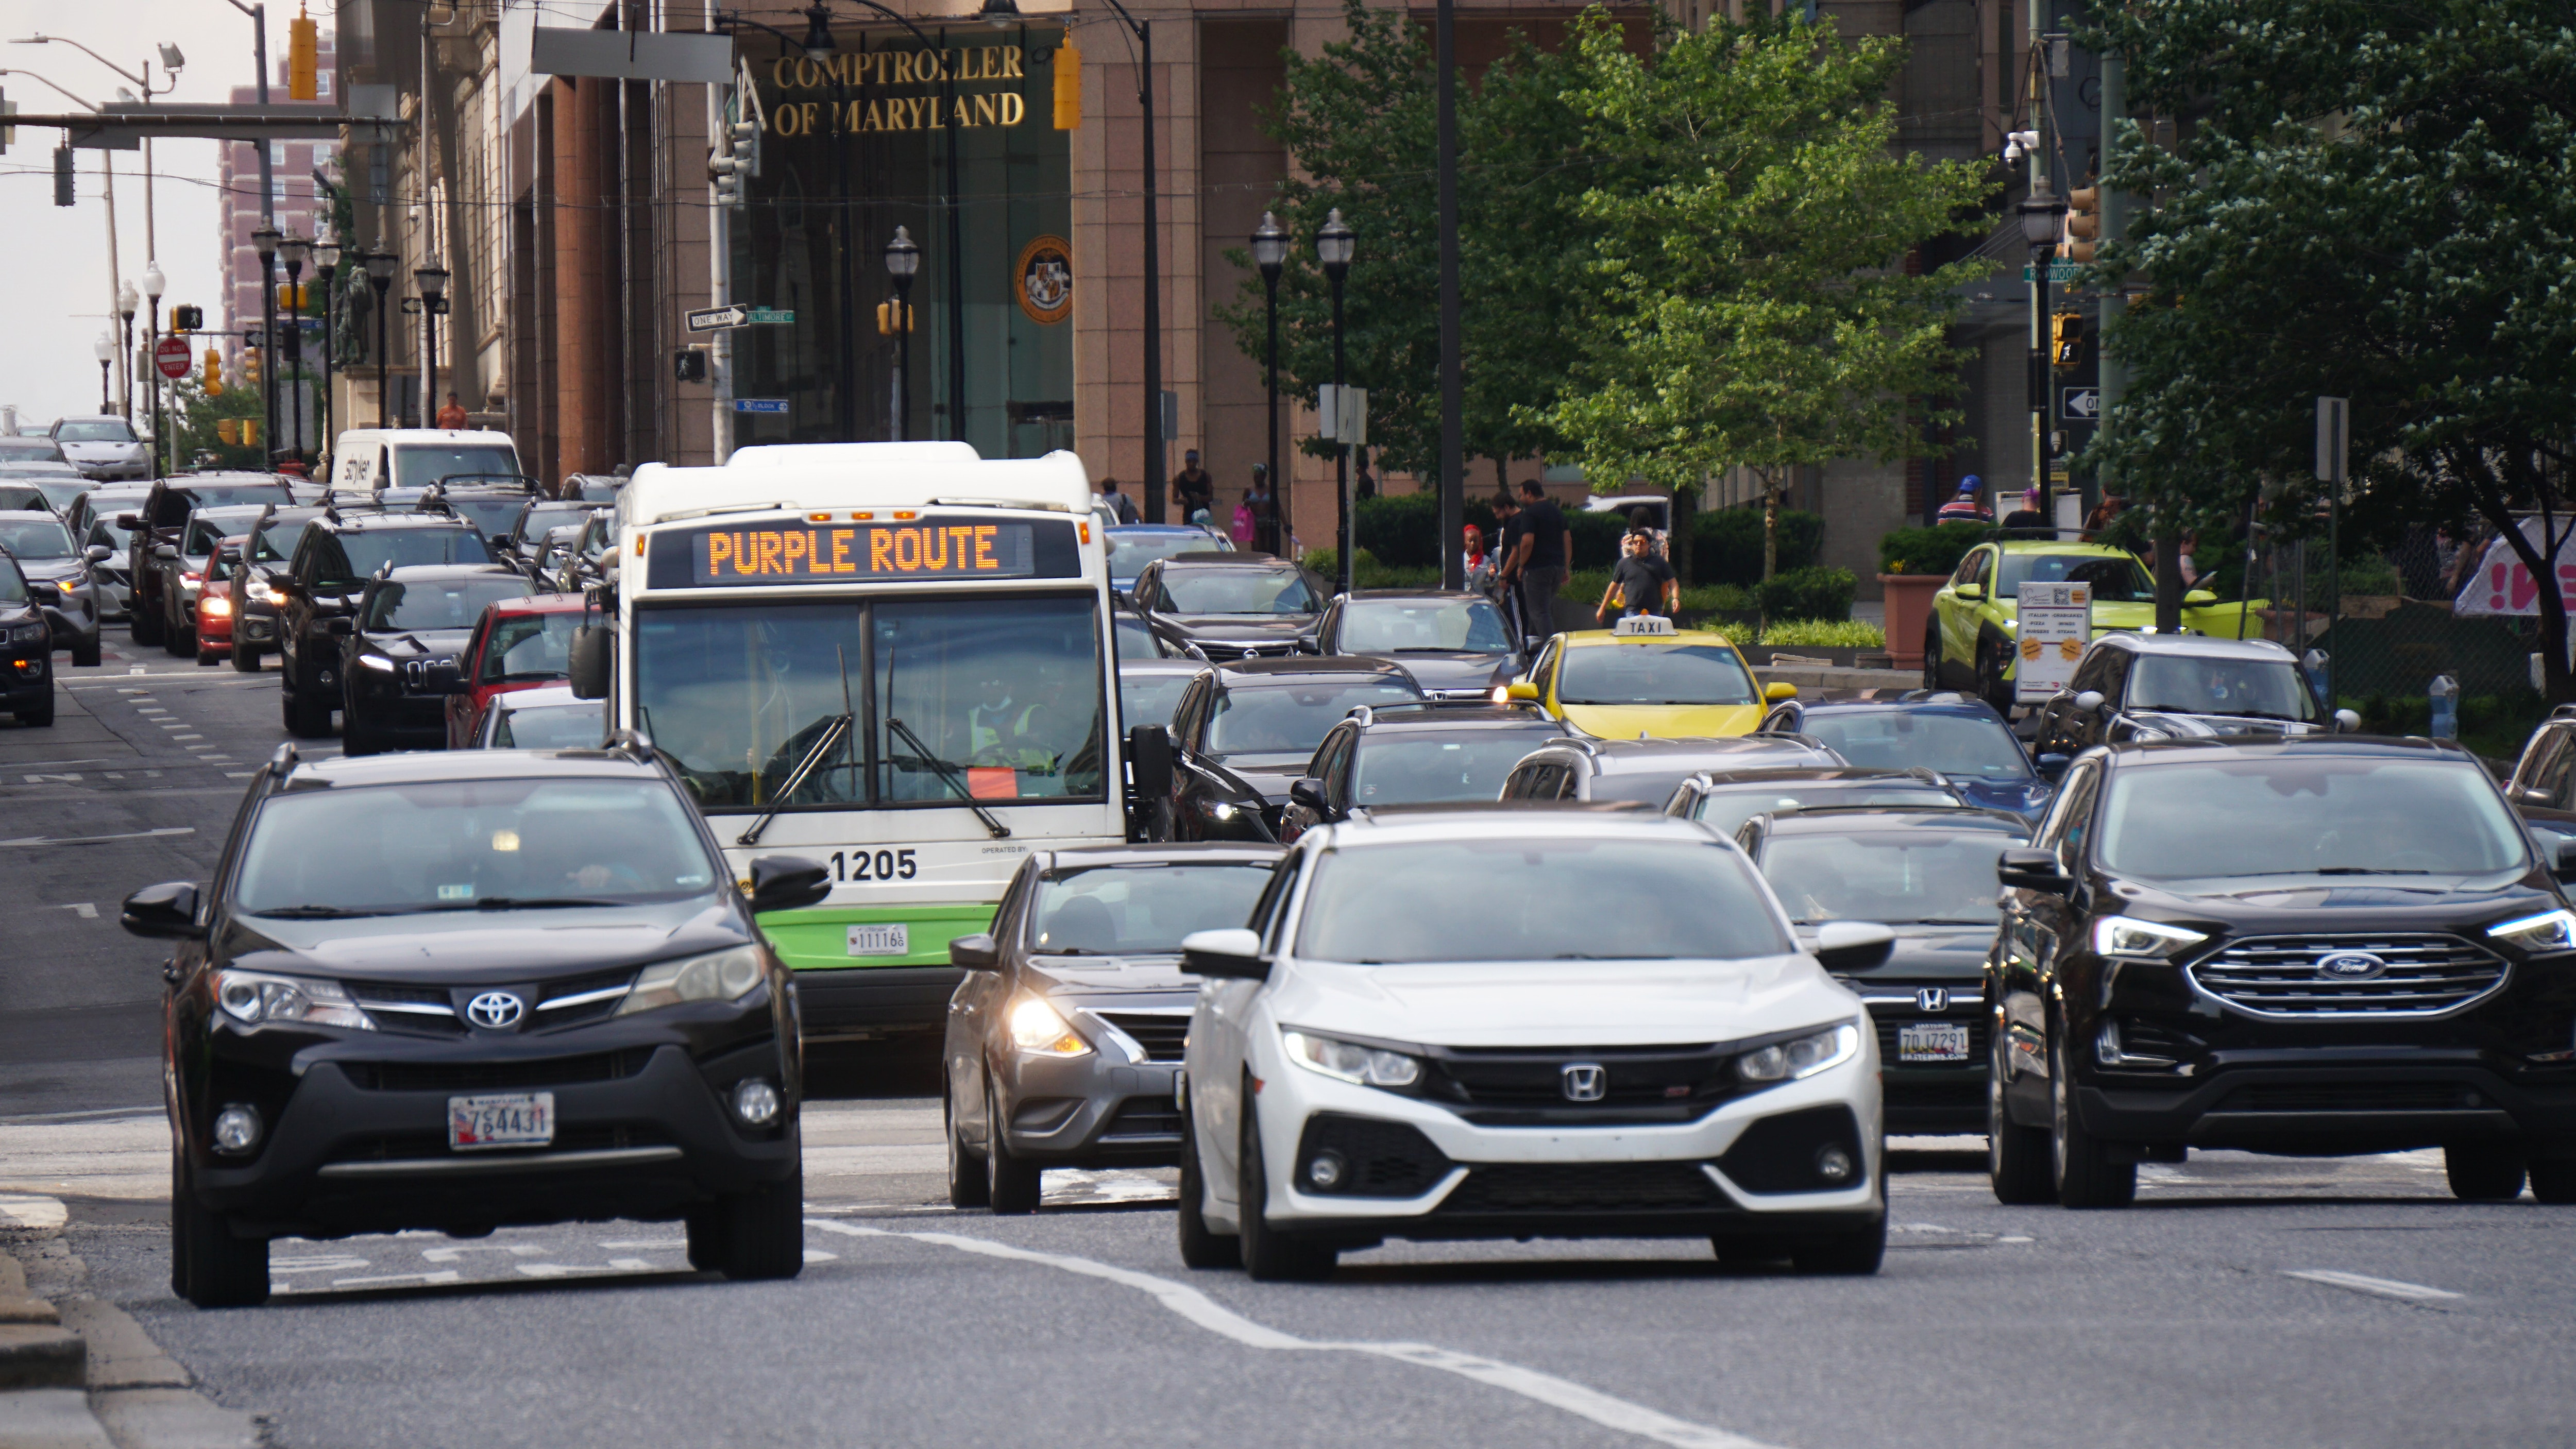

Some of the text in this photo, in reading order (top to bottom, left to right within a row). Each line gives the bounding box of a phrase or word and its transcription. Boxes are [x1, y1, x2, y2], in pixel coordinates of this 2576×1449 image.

[773, 45, 1024, 88] COMPTROLLER
[774, 93, 1024, 136] OF MARYLAND
[694, 313, 733, 326] ONE WAY
[748, 313, 786, 321] ALTIMORE
[709, 526, 998, 576] PURPLE ROUTE
[1631, 622, 1661, 633] TAXI
[831, 849, 917, 881] 1205
[2334, 958, 2370, 973] Ford
